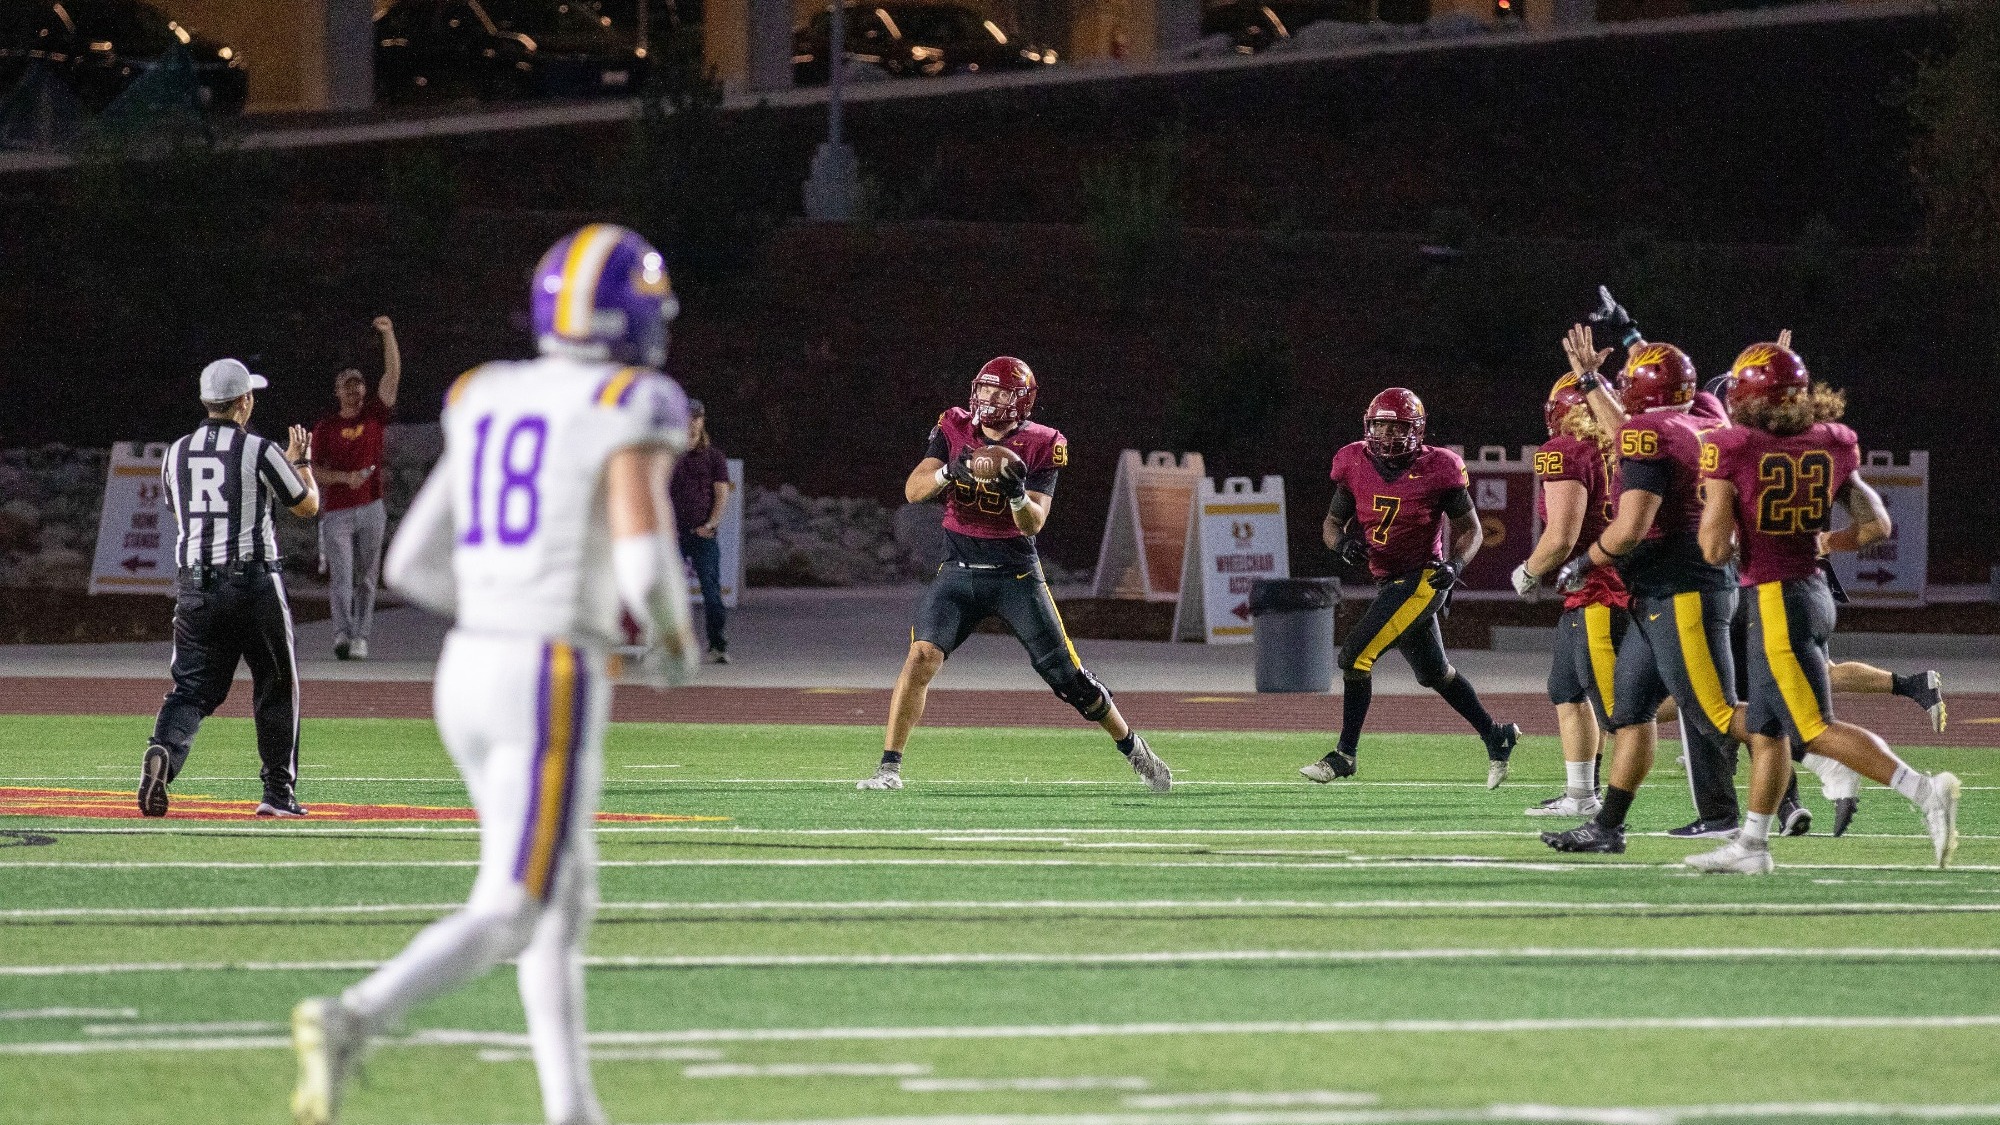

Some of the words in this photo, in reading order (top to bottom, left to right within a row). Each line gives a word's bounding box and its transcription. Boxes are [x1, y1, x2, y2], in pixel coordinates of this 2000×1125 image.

[1534, 451, 1564, 476] 52
[1621, 429, 1659, 457] 56
[187, 456, 229, 513] R
[461, 414, 549, 546] 18
[1756, 450, 1833, 536] 23
[1372, 494, 1402, 545] 7
